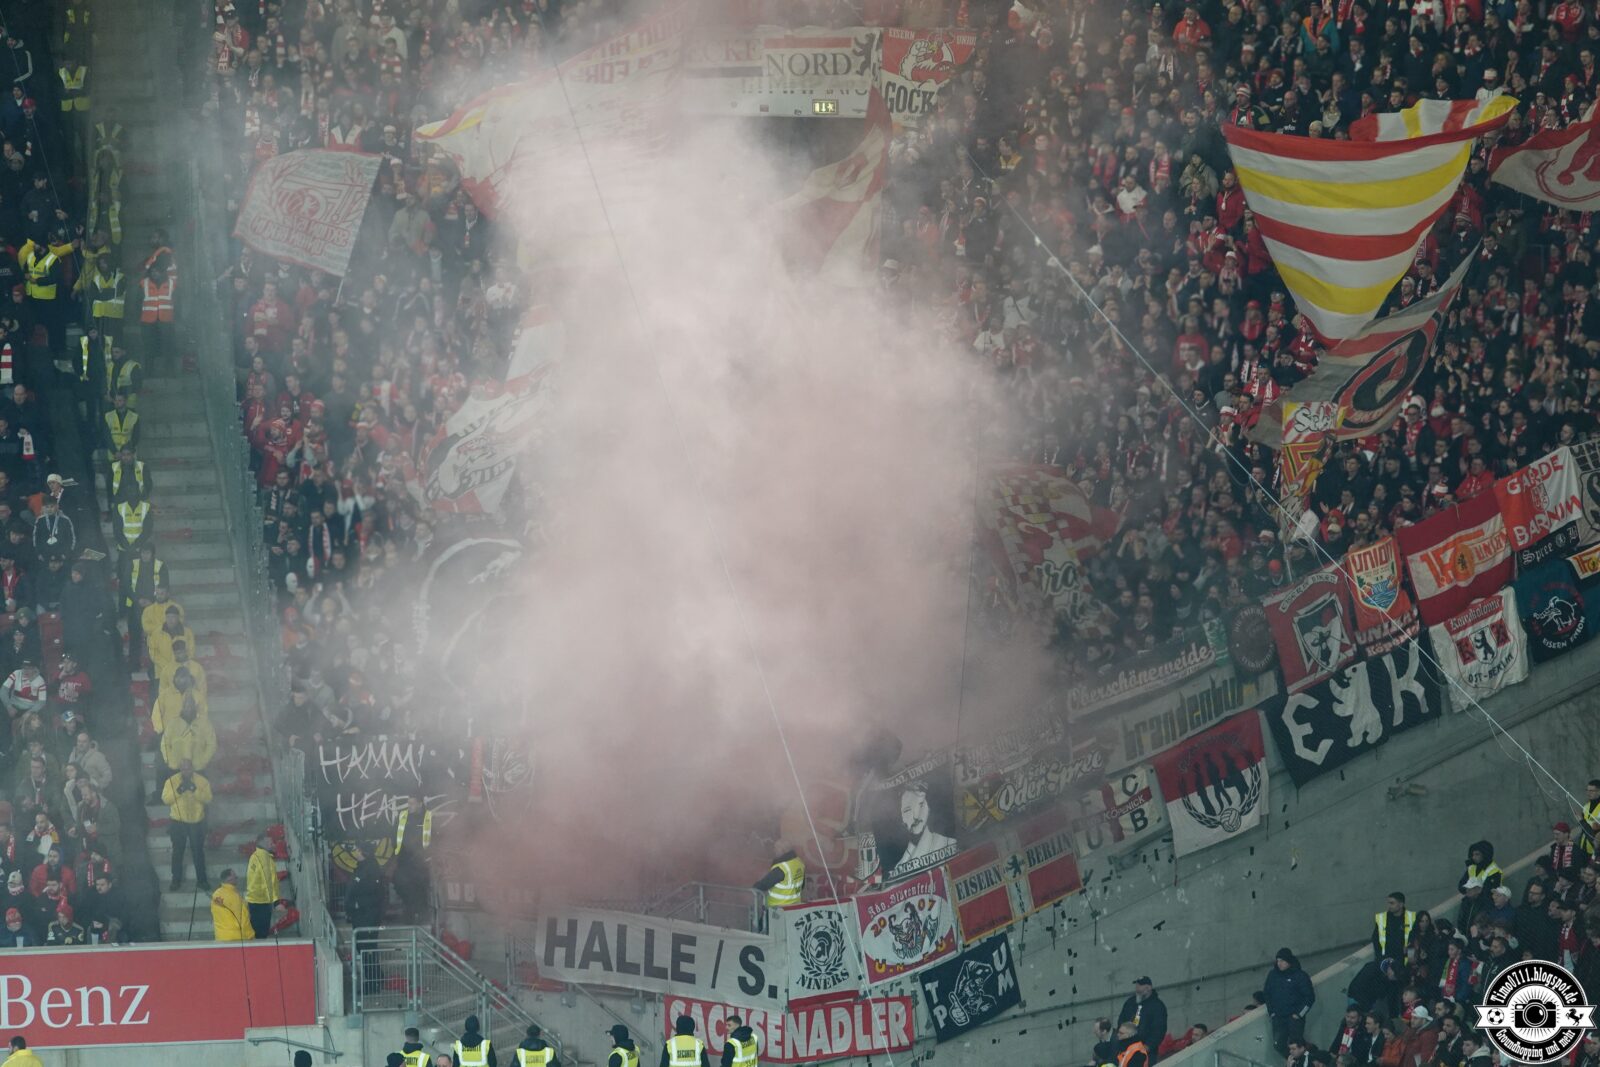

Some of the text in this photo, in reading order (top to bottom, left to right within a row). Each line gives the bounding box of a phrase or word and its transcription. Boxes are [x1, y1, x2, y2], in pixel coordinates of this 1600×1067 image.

[889, 29, 977, 46] EISERN UNION
[767, 52, 852, 77] NORD
[885, 81, 936, 114] GOCK
[1506, 455, 1563, 495] GARDE
[1513, 494, 1583, 547] BARNIM
[1352, 540, 1394, 573] UNION
[1472, 527, 1509, 562] UNION
[1522, 542, 1553, 566] Spree
[1067, 641, 1216, 712] Oberschöneweide
[955, 831, 1074, 901] EISERN BERLIN
[544, 916, 698, 985] HALLE
[737, 944, 778, 999] S.
[796, 968, 850, 990] NINERS
[0, 974, 150, 1030] Benz
